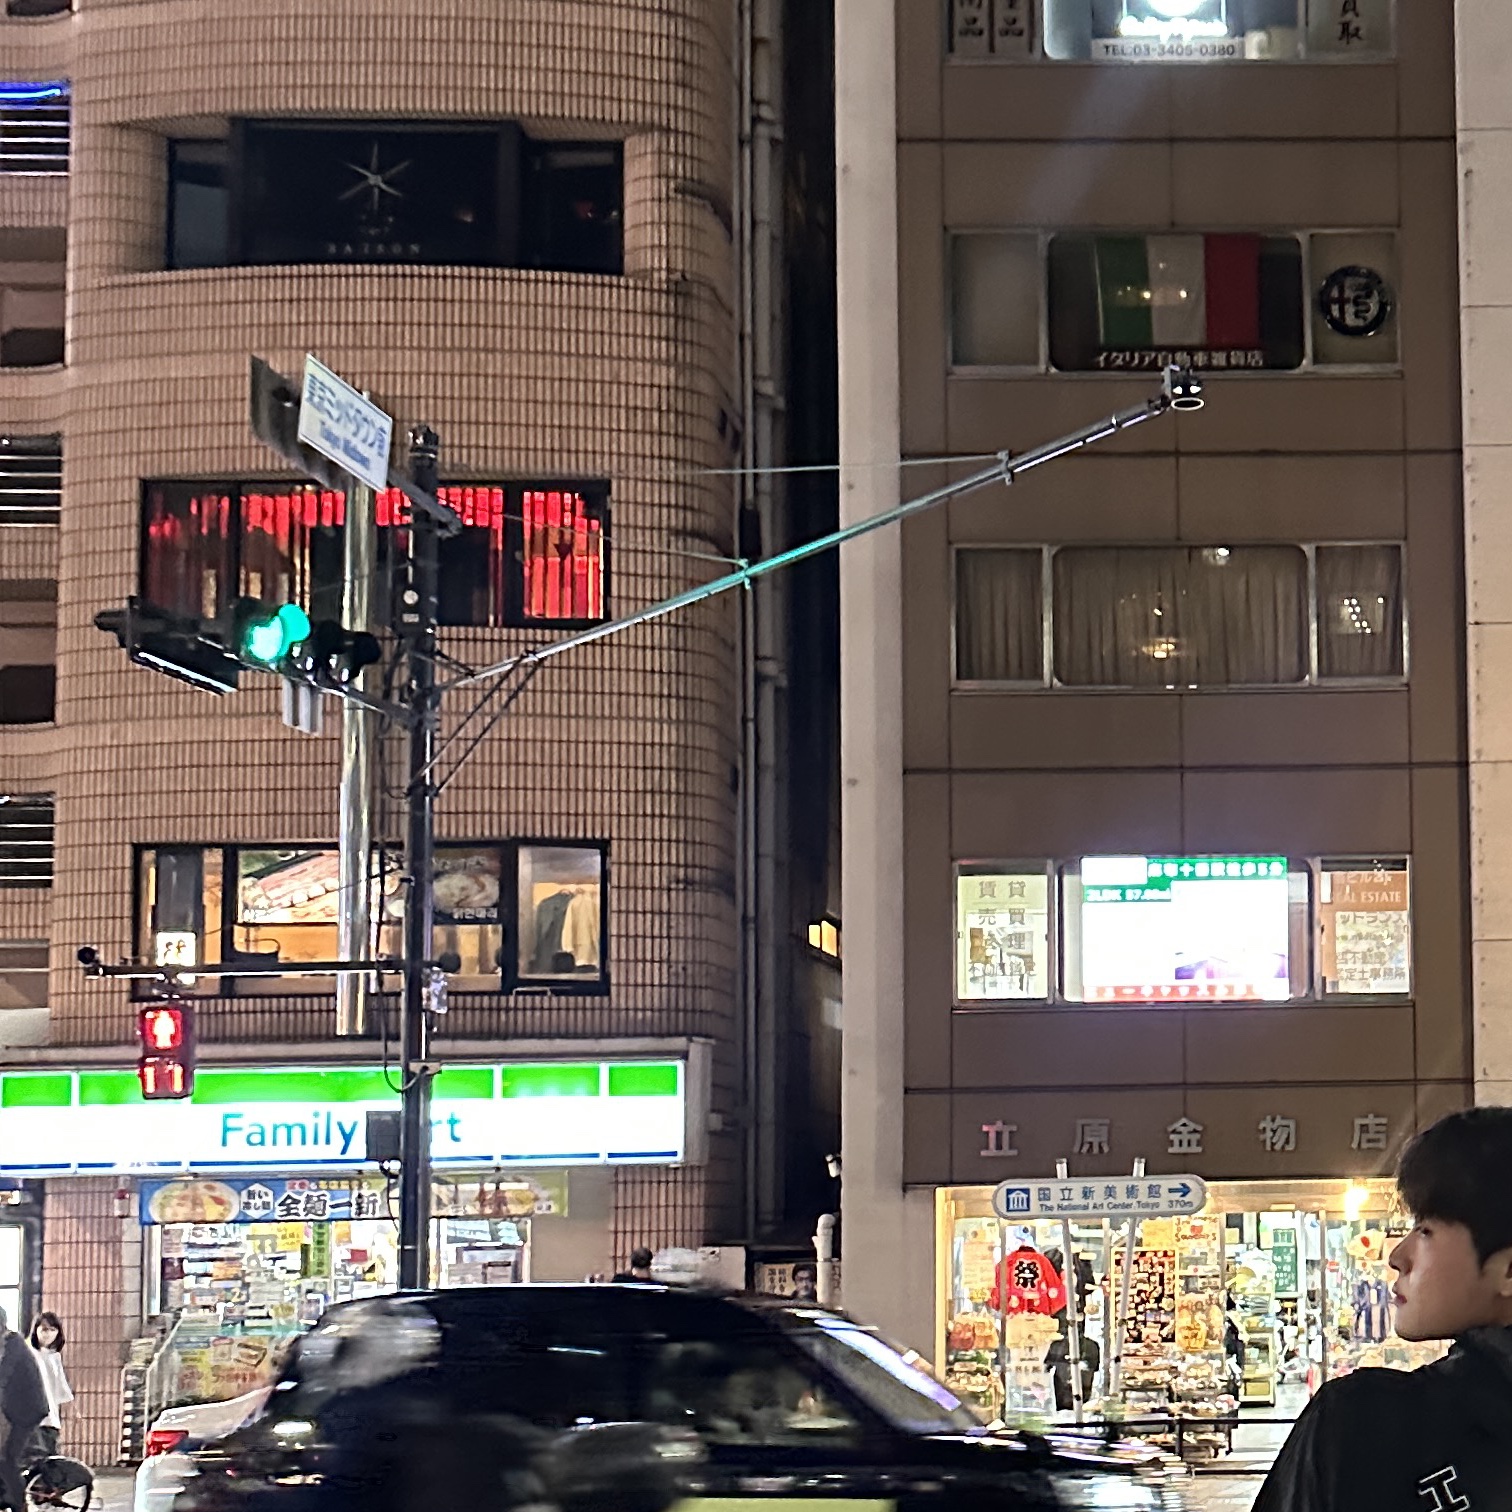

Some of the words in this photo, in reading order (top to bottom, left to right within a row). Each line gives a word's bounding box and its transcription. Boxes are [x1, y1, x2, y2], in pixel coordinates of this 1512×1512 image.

[1360, 890, 1402, 903] ESTATE
[980, 1114, 1389, 1157] 立原金物店
[1037, 1183, 1162, 1202] 国立新美術館
[1039, 1203, 1055, 1212] The
[1056, 1201, 1090, 1211] National
[1092, 1201, 1104, 1210] Art
[1014, 1259, 1042, 1289] 祭
